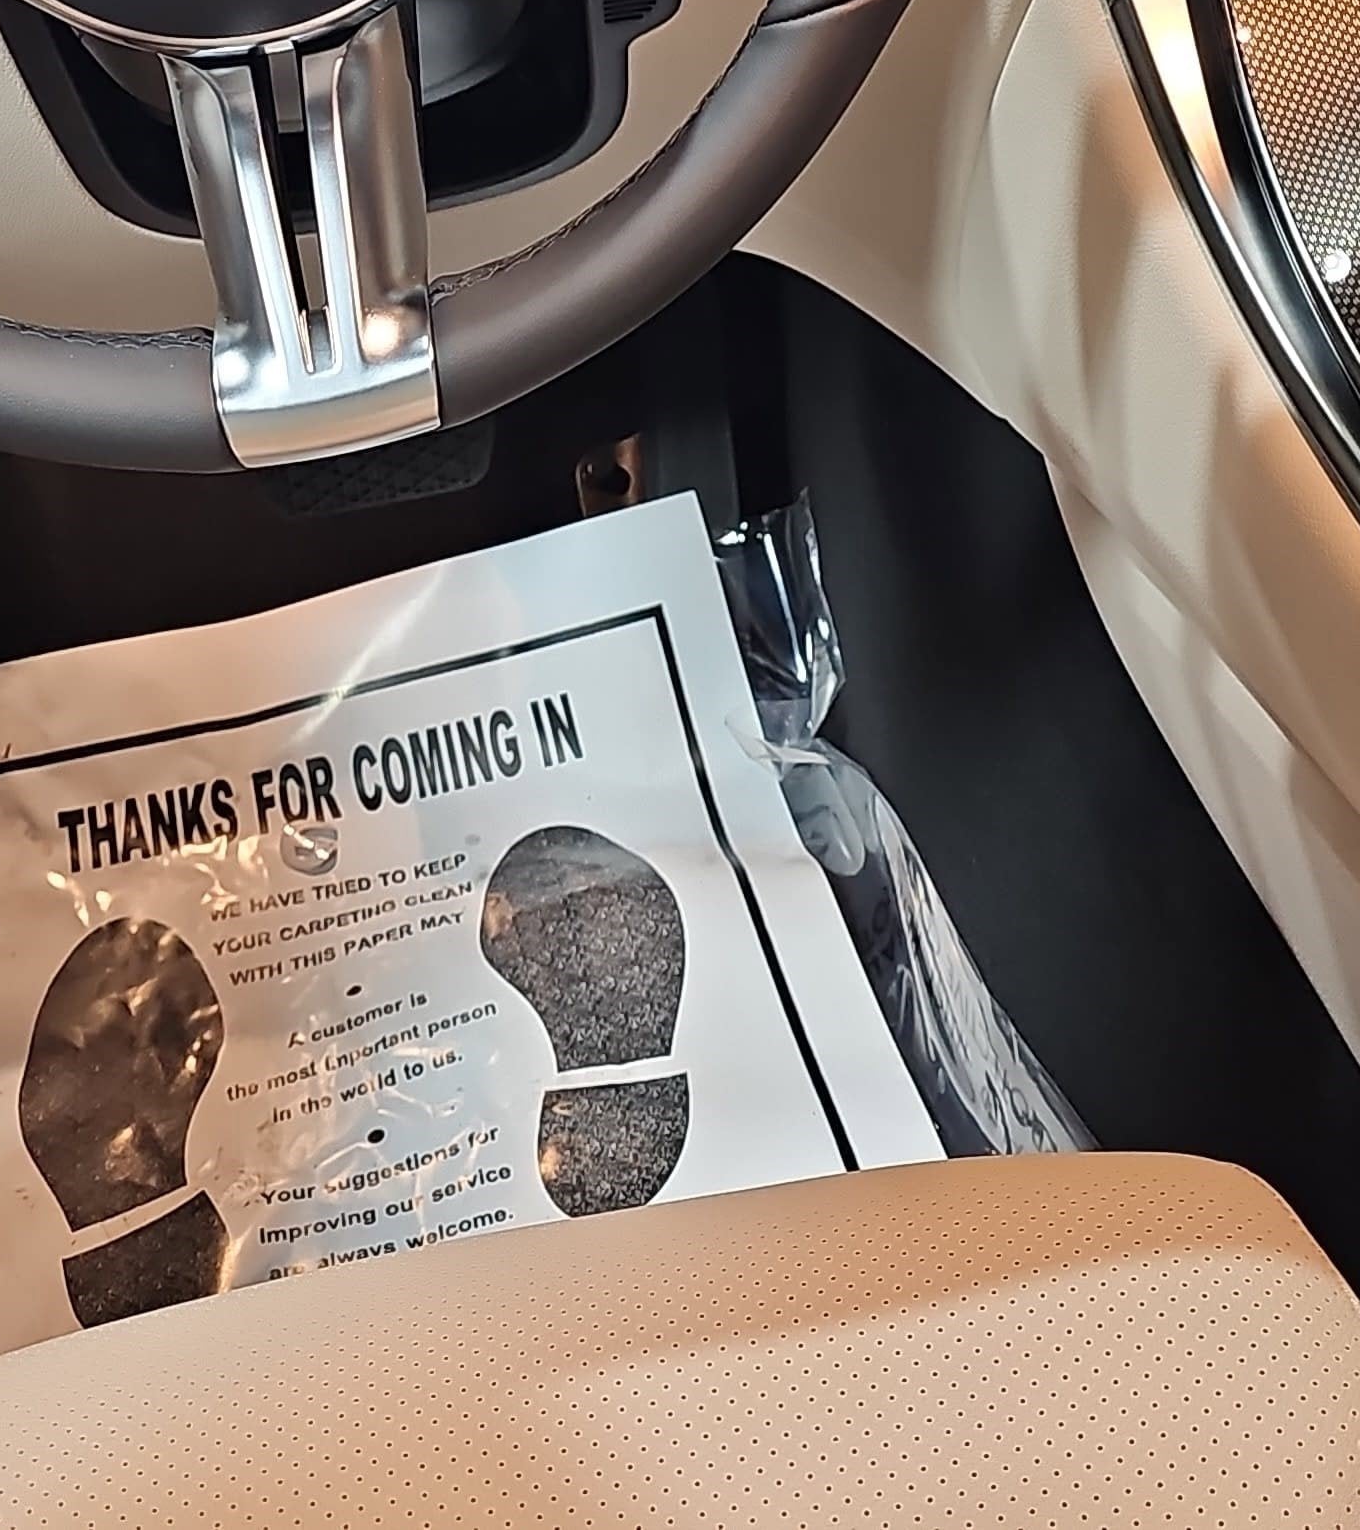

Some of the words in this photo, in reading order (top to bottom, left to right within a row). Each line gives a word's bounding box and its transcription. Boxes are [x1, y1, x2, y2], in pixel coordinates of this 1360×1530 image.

[58, 779, 238, 872] THANKS
[252, 756, 342, 833] FOR
[353, 710, 522, 811] COMING
[530, 693, 583, 768] IN
[250, 889, 305, 913] HAVE
[312, 877, 372, 901] TRIED
[379, 869, 406, 888] TO
[414, 853, 466, 880] KEEP
[213, 931, 272, 956] YOUR
[280, 901, 396, 942] CARPETING
[404, 881, 472, 907] CLEAN
[230, 961, 282, 986] WITH
[290, 947, 336, 970] THIS
[344, 923, 413, 956] PAPER
[421, 911, 464, 931] MAT
[227, 1083, 259, 1102] the
[267, 1060, 318, 1091] most
[427, 1002, 497, 1038] person
[311, 999, 403, 1043] customer
[301, 1097, 332, 1116] the
[404, 1061, 424, 1081] to
[432, 1052, 463, 1070] us.
[261, 1183, 316, 1206] Your
[324, 1142, 460, 1195] suggestions
[468, 1126, 498, 1148] for
[385, 1195, 424, 1217] our
[431, 1165, 511, 1203] service
[406, 1209, 514, 1250] welcome.
